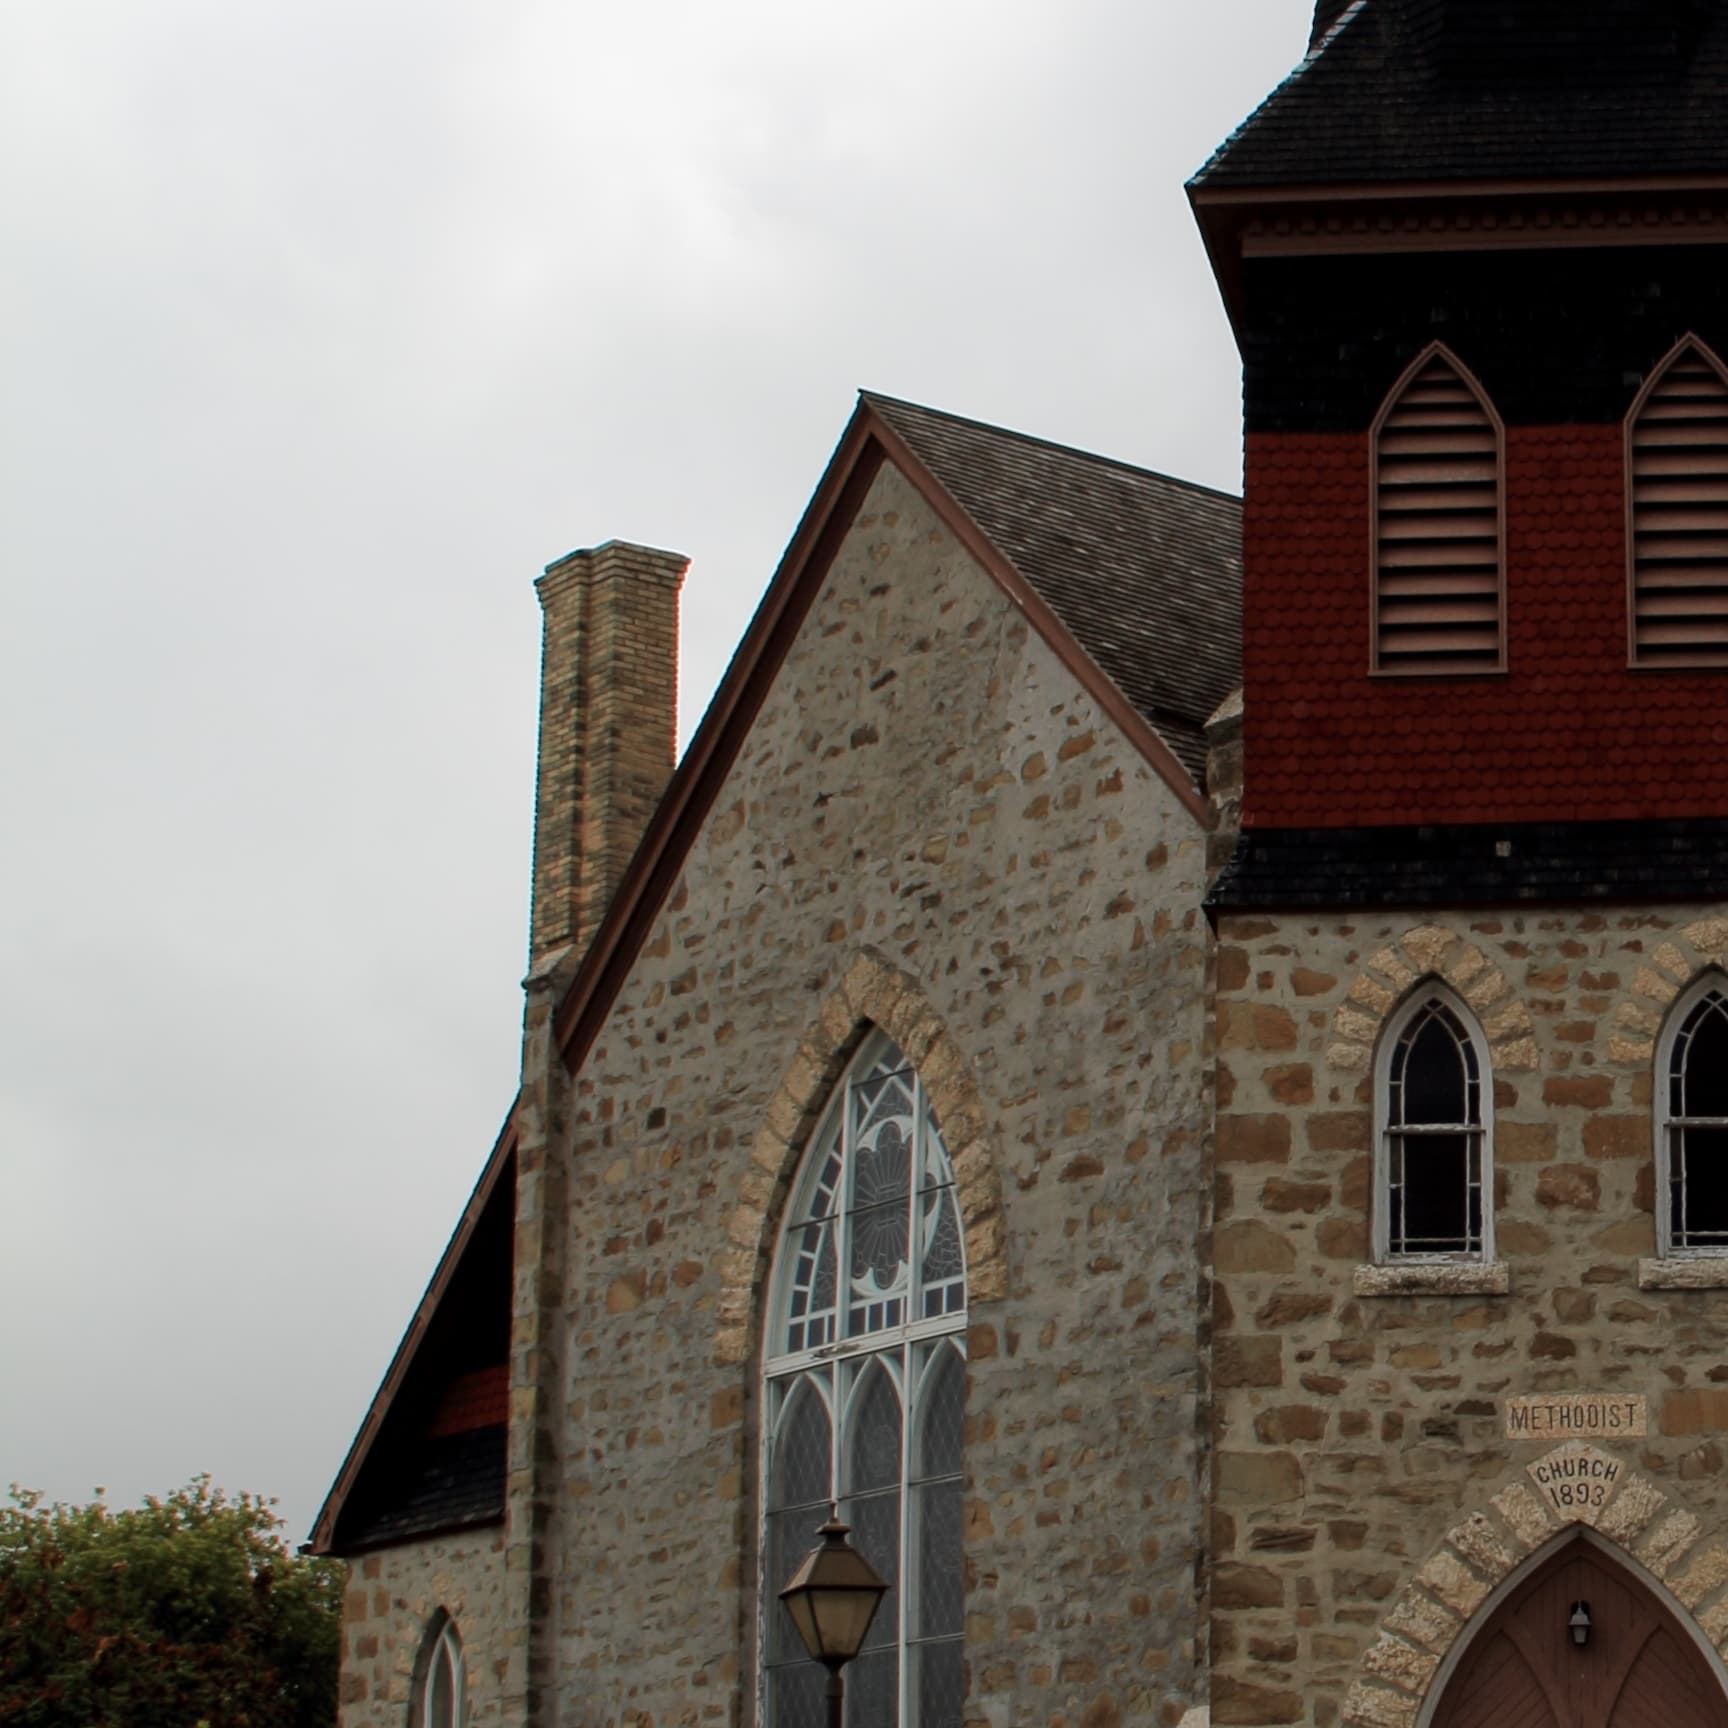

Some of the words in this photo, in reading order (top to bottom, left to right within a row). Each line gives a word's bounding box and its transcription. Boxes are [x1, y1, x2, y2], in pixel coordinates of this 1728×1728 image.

[1511, 1402, 1637, 1430] METHODIST
[1536, 1457, 1618, 1483] CHURCH
[1550, 1483, 1605, 1508] 1893
